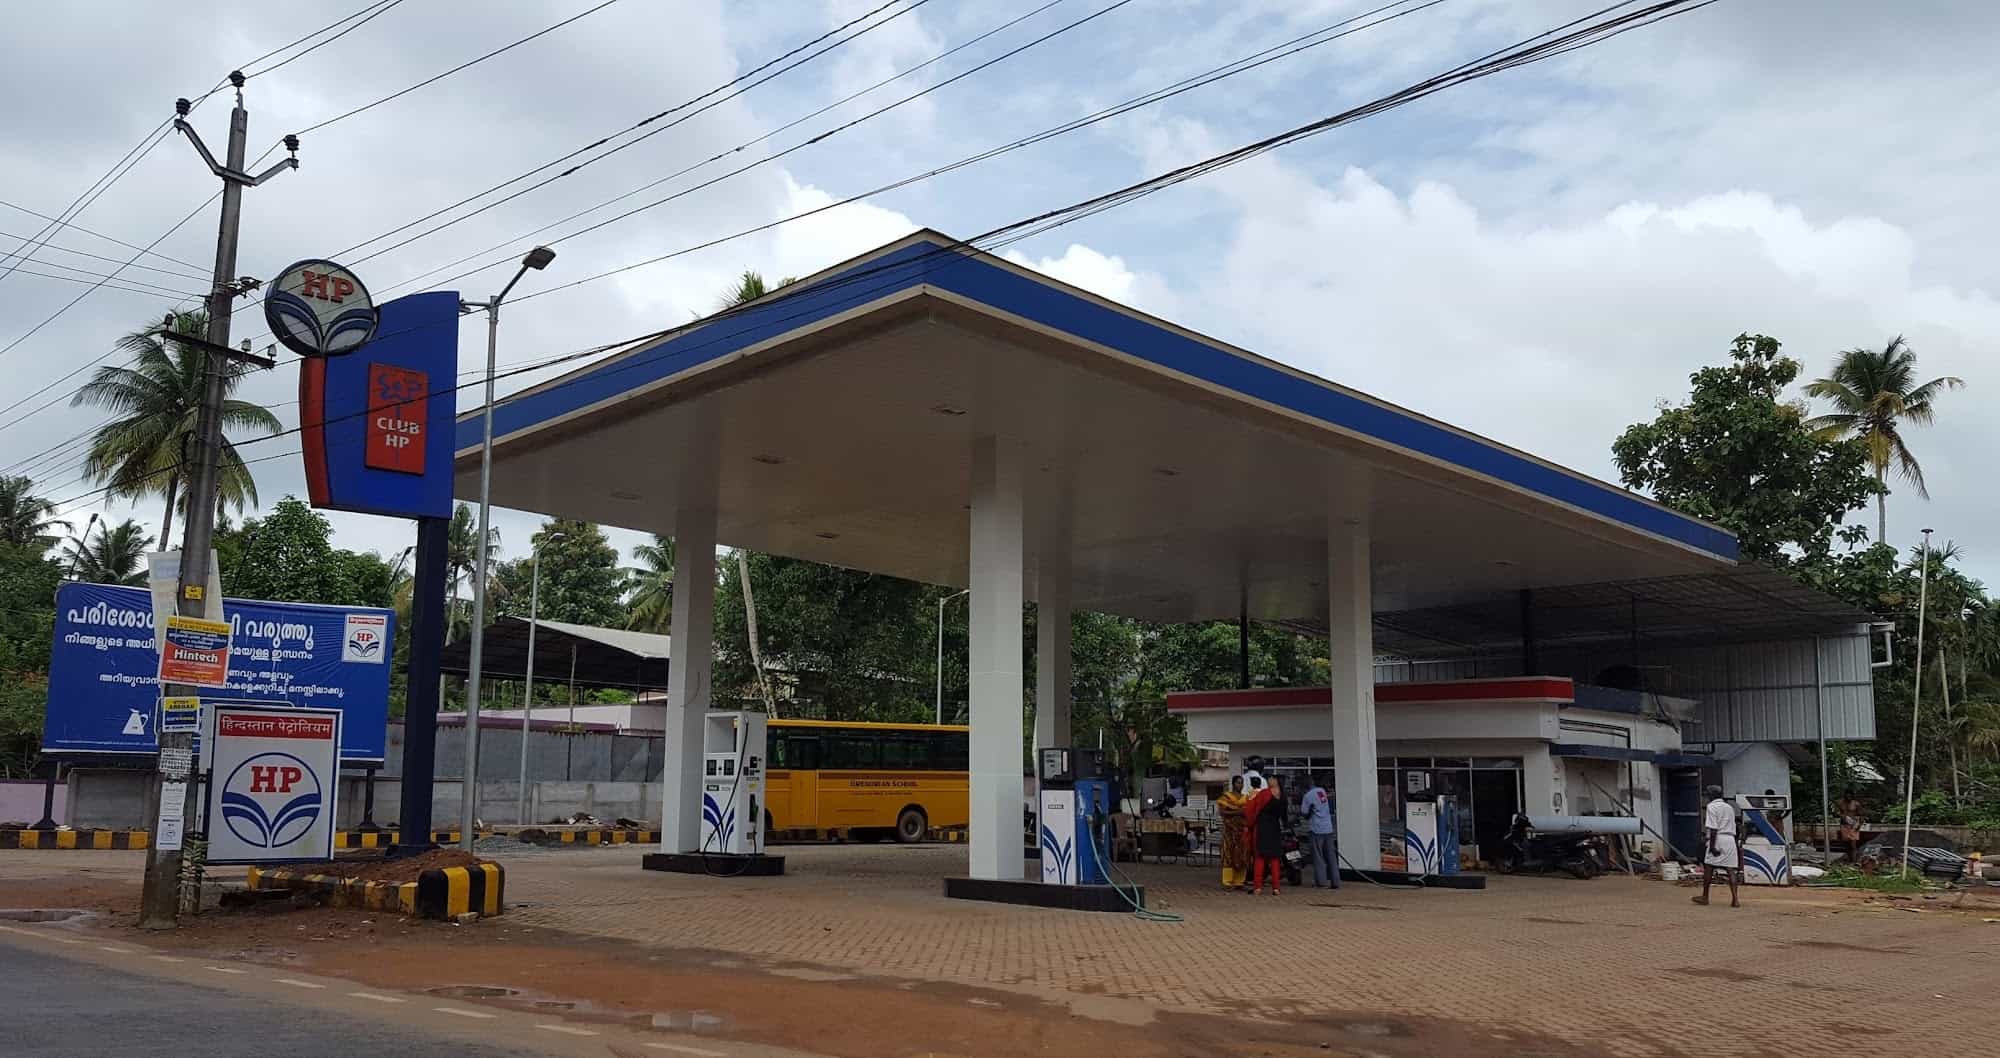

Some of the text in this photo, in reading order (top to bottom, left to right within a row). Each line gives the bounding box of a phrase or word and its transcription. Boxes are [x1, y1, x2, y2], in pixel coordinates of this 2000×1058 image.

[302, 270, 354, 303] HP
[377, 417, 420, 434] CLUB
[386, 433, 409, 449] HP
[65, 632, 122, 650] നിങ്ങളുടെ
[357, 633, 373, 642] HP
[174, 649, 218, 663] Hintech
[250, 766, 302, 792] HP
